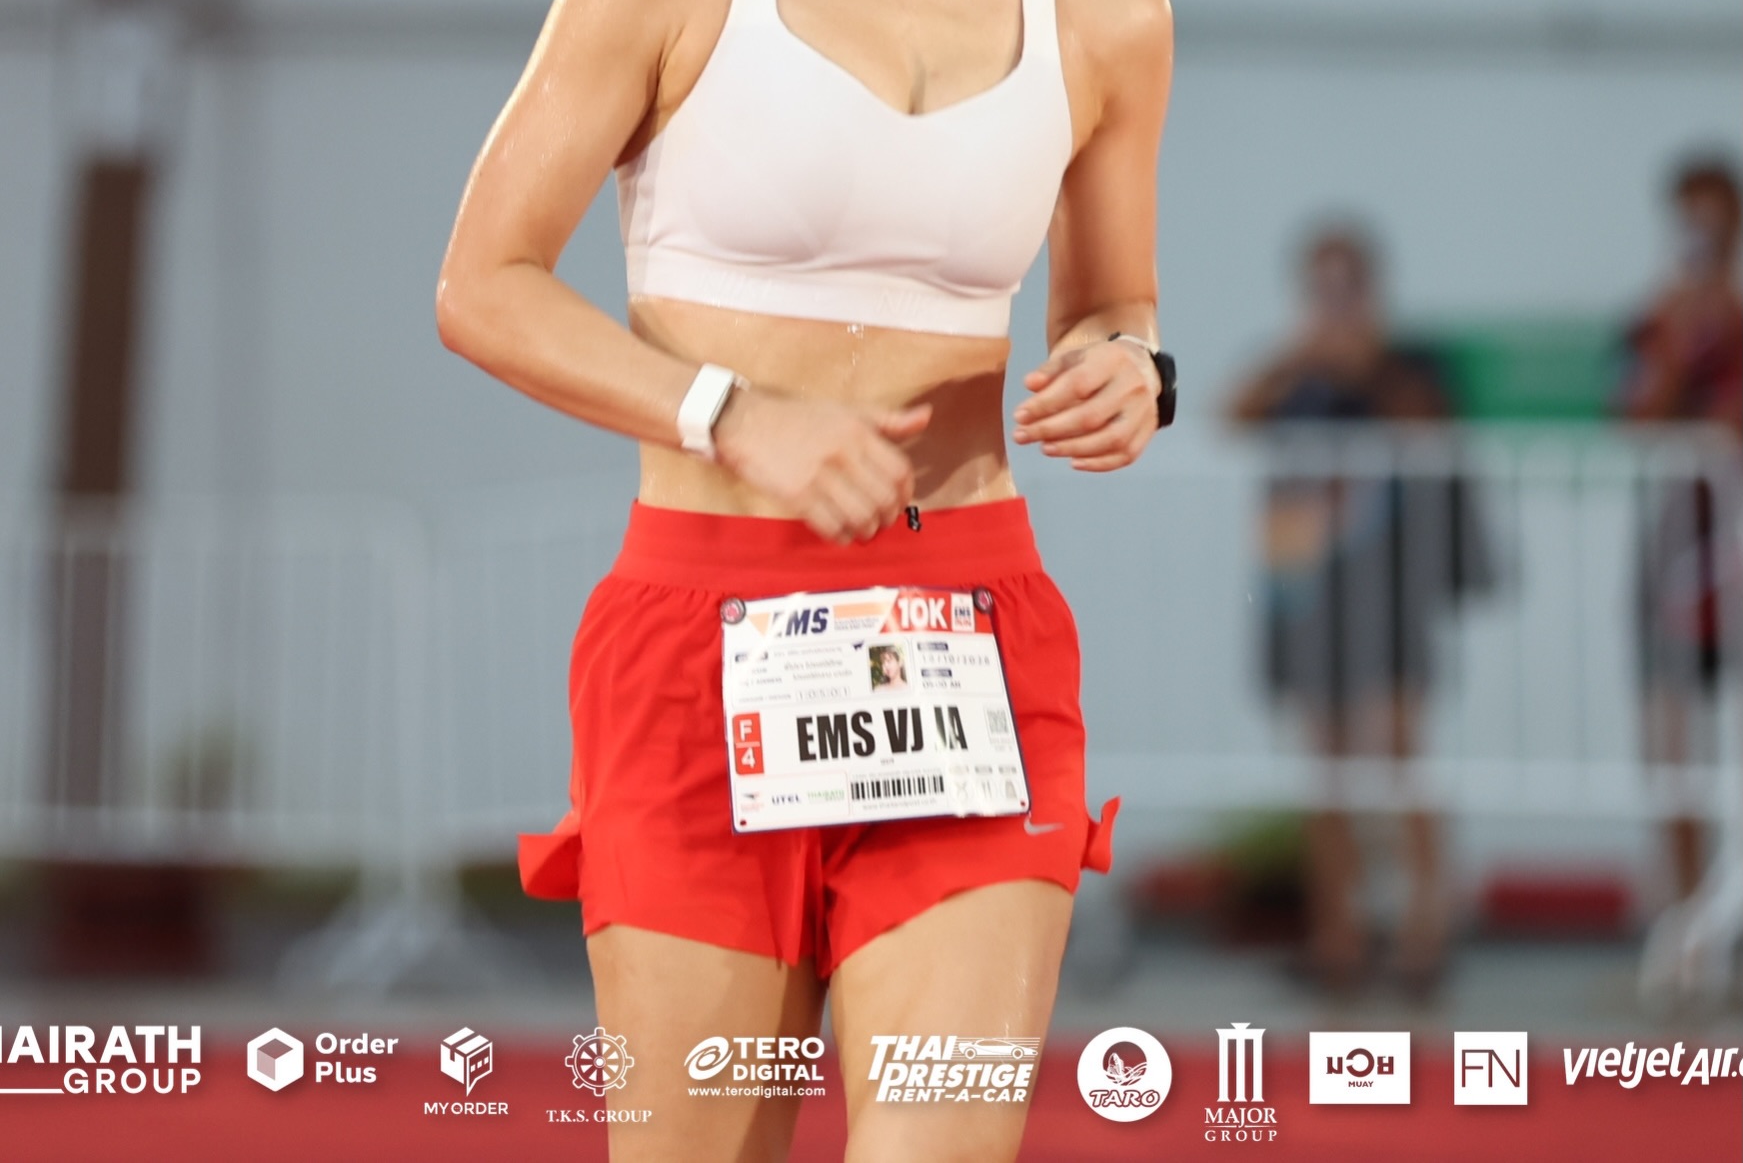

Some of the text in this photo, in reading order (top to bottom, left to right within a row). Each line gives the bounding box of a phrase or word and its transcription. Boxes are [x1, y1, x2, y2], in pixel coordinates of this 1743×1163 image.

[898, 597, 948, 631] 10K
[738, 719, 753, 741] F
[796, 709, 876, 762] EMS
[883, 706, 924, 754] VJ
[741, 748, 756, 768] 4
